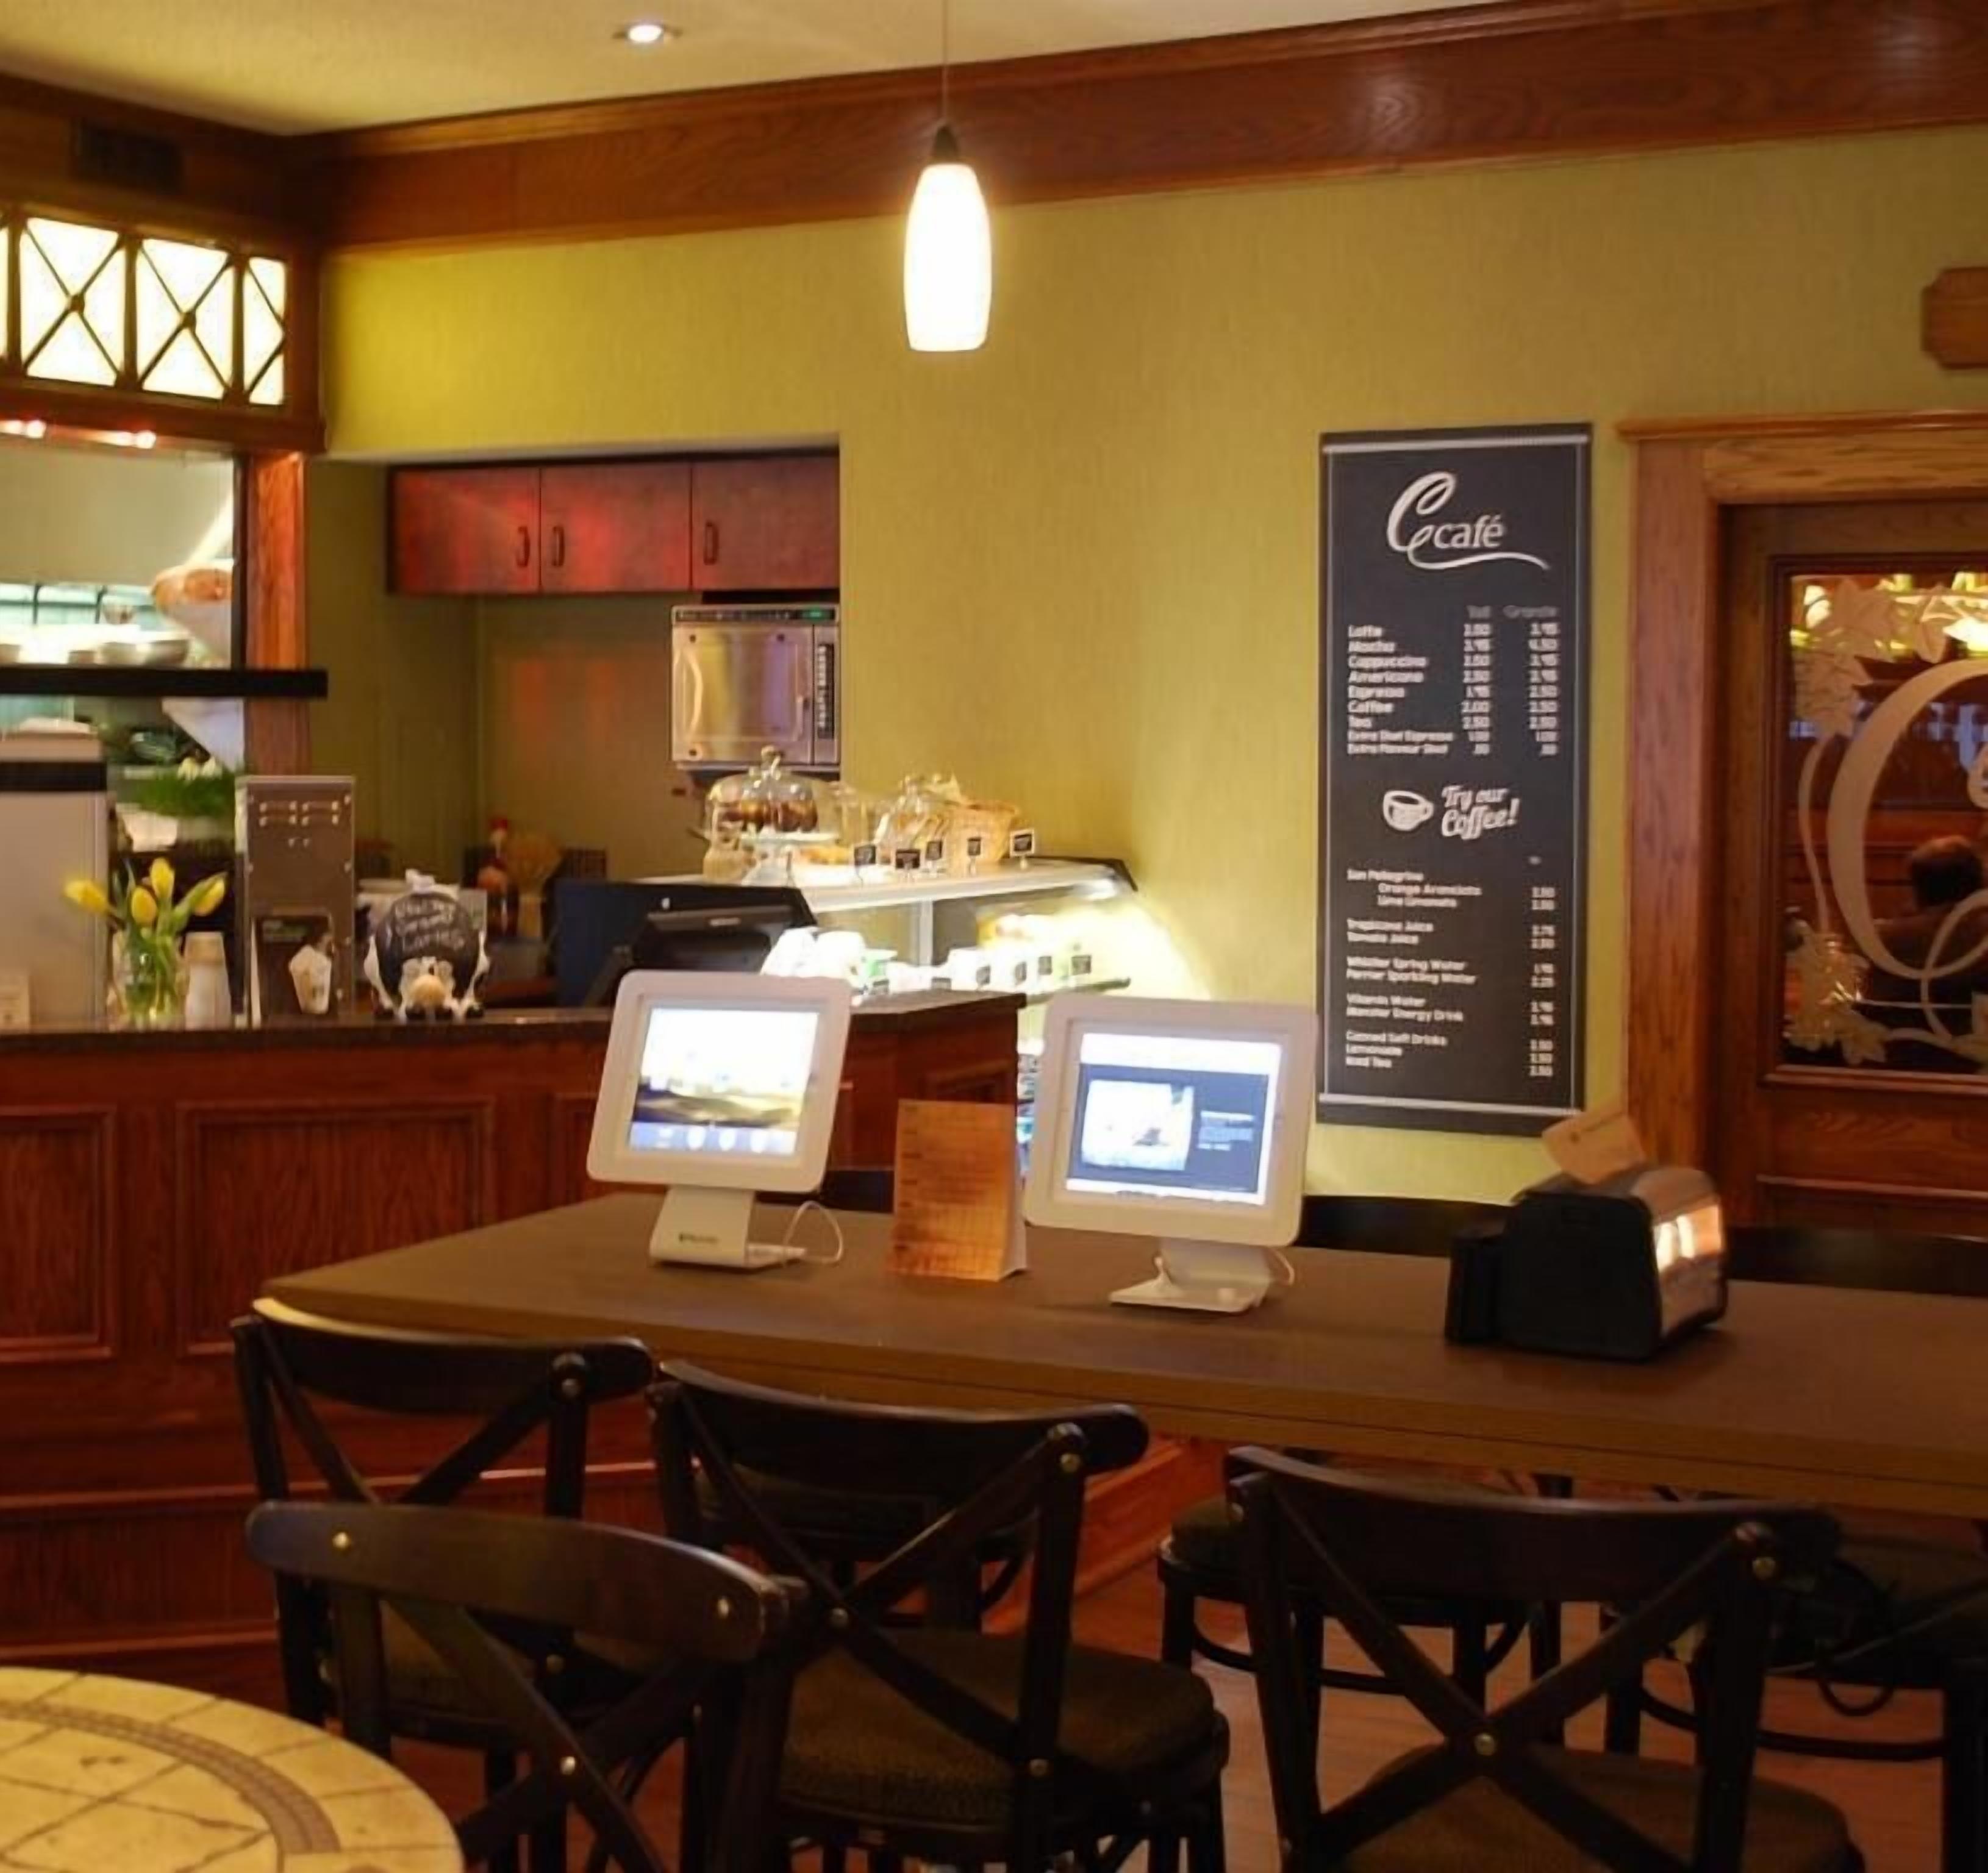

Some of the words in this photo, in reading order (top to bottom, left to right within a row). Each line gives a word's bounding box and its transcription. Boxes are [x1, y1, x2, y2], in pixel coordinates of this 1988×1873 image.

[1348, 655, 1427, 668] Cappuccino
[1348, 671, 1425, 683] Americano
[1348, 686, 1405, 700] Espresso
[1348, 700, 1394, 713] Coffee
[1442, 785, 1473, 813] Try
[1476, 788, 1510, 803] our
[1442, 797, 1520, 840] Coffee!
[1378, 883, 1421, 896] Orange
